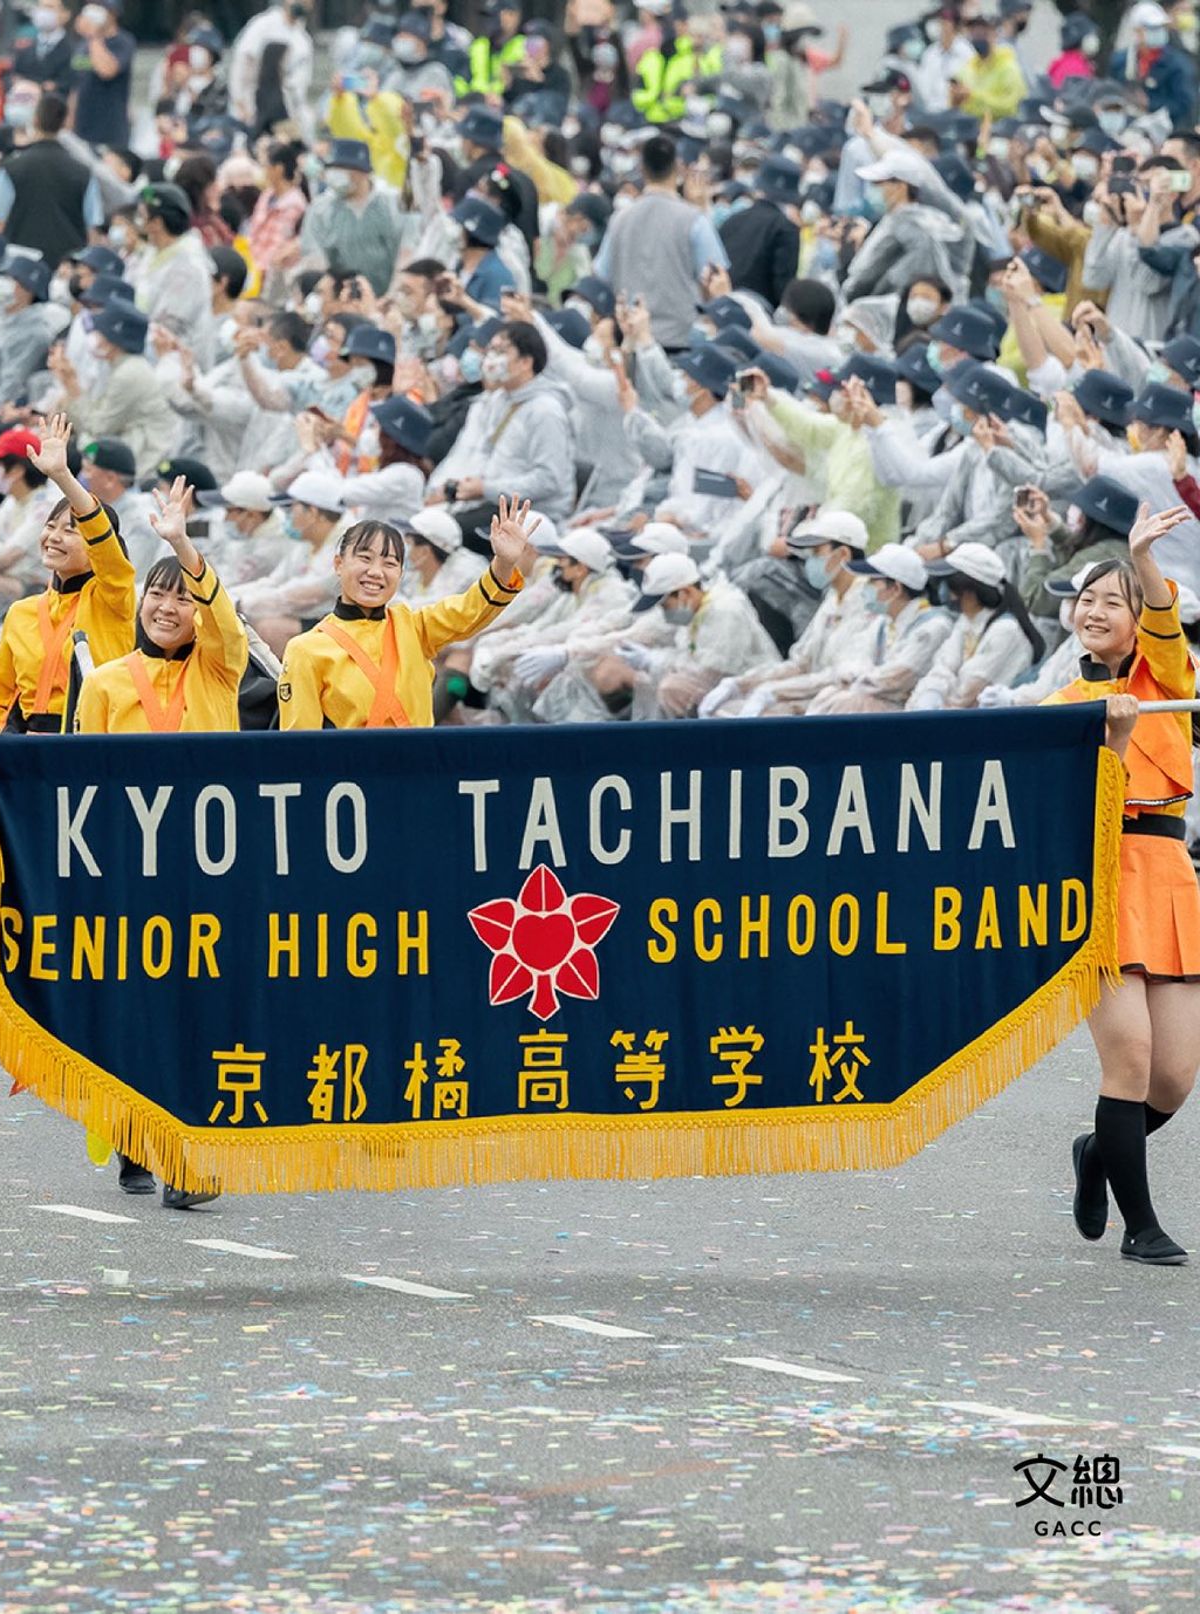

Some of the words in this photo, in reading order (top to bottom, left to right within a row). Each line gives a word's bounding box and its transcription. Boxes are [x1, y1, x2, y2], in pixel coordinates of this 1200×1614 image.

[57, 782, 368, 878] KYOTO
[458, 759, 1016, 872] TACHIBANA
[1, 906, 221, 981] SENIOR
[268, 910, 429, 978] HIGH
[647, 891, 907, 963] SCHOOL
[933, 878, 1089, 952] BAND
[208, 1020, 871, 1124] 京都橘高等学校
